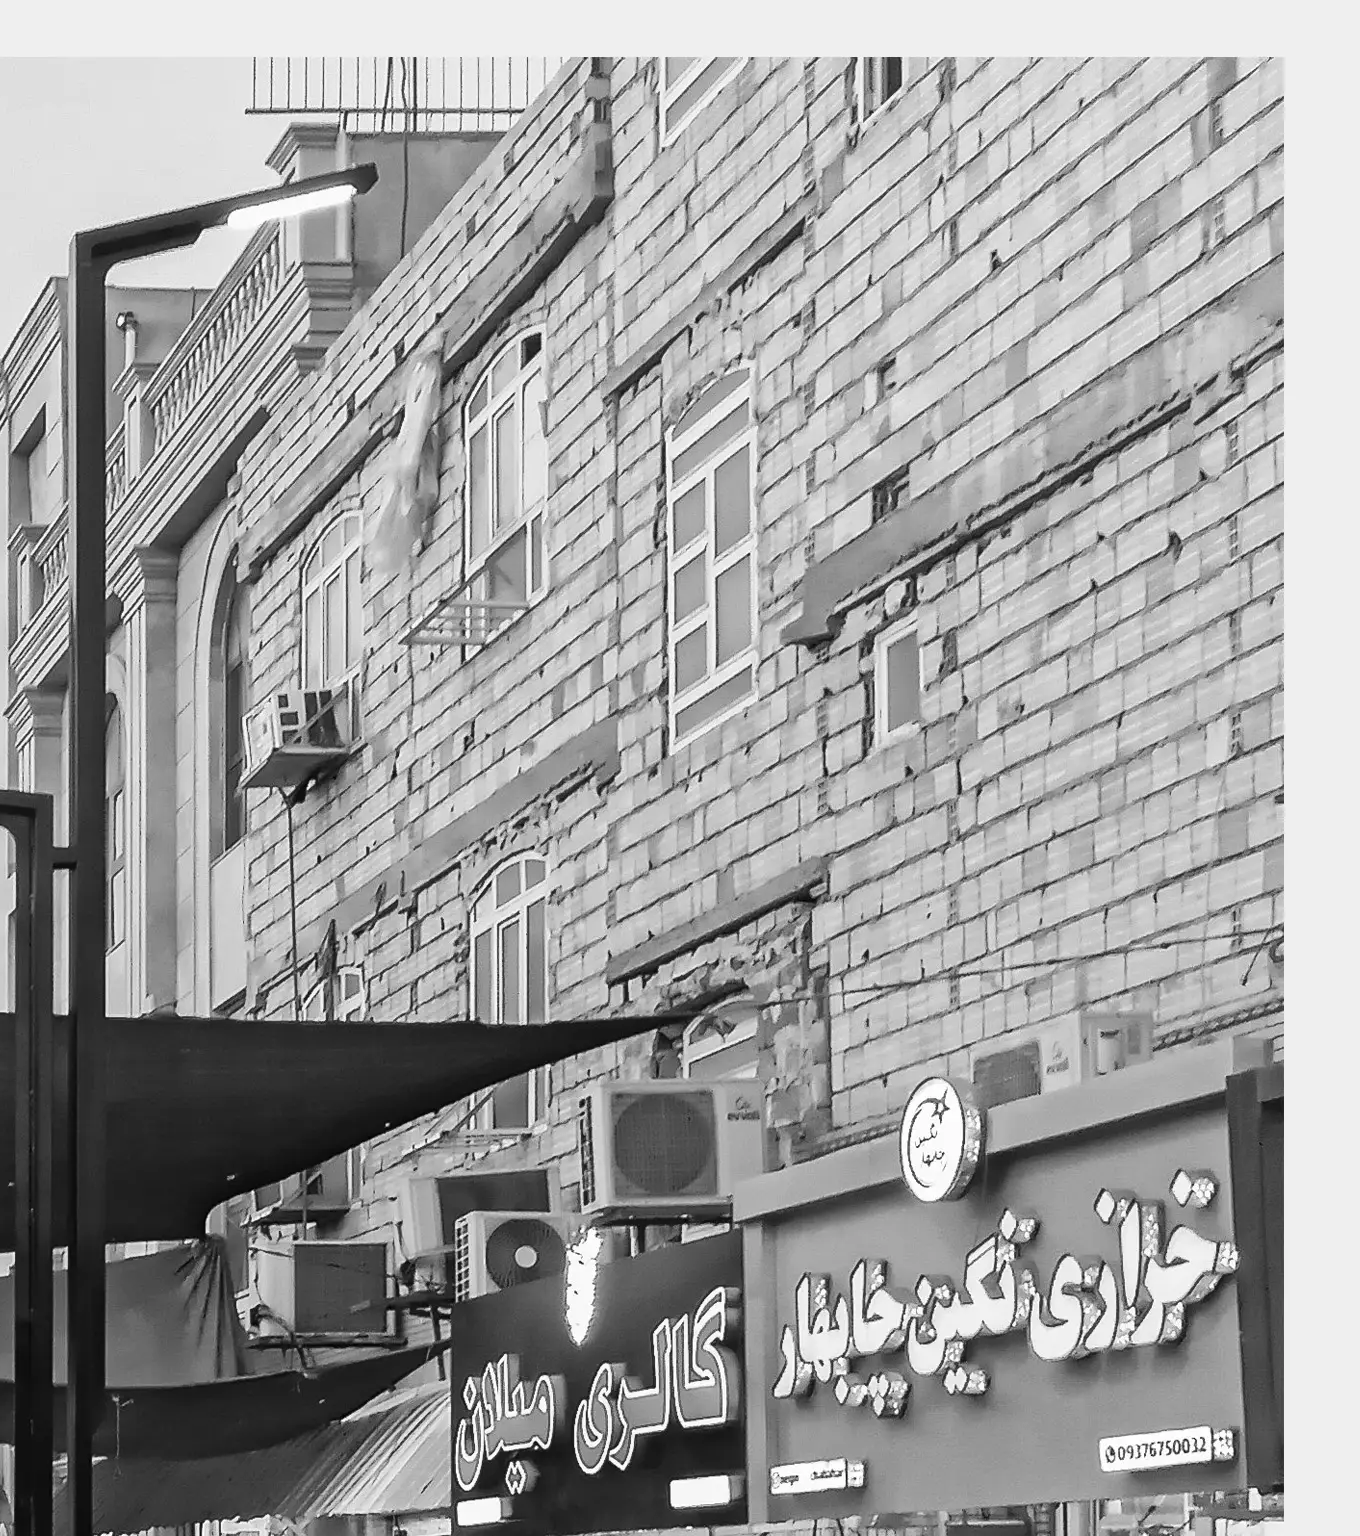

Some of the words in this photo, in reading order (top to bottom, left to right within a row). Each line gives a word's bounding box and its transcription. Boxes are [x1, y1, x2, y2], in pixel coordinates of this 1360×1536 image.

[772, 1258, 910, 1418] چابهار
[906, 1208, 1020, 1395] نگین
[1026, 1168, 1222, 1361] خرازی
[455, 1352, 555, 1495] میلان
[573, 1285, 728, 1475] گالری
[1117, 1436, 1207, 1461] 09376750032
